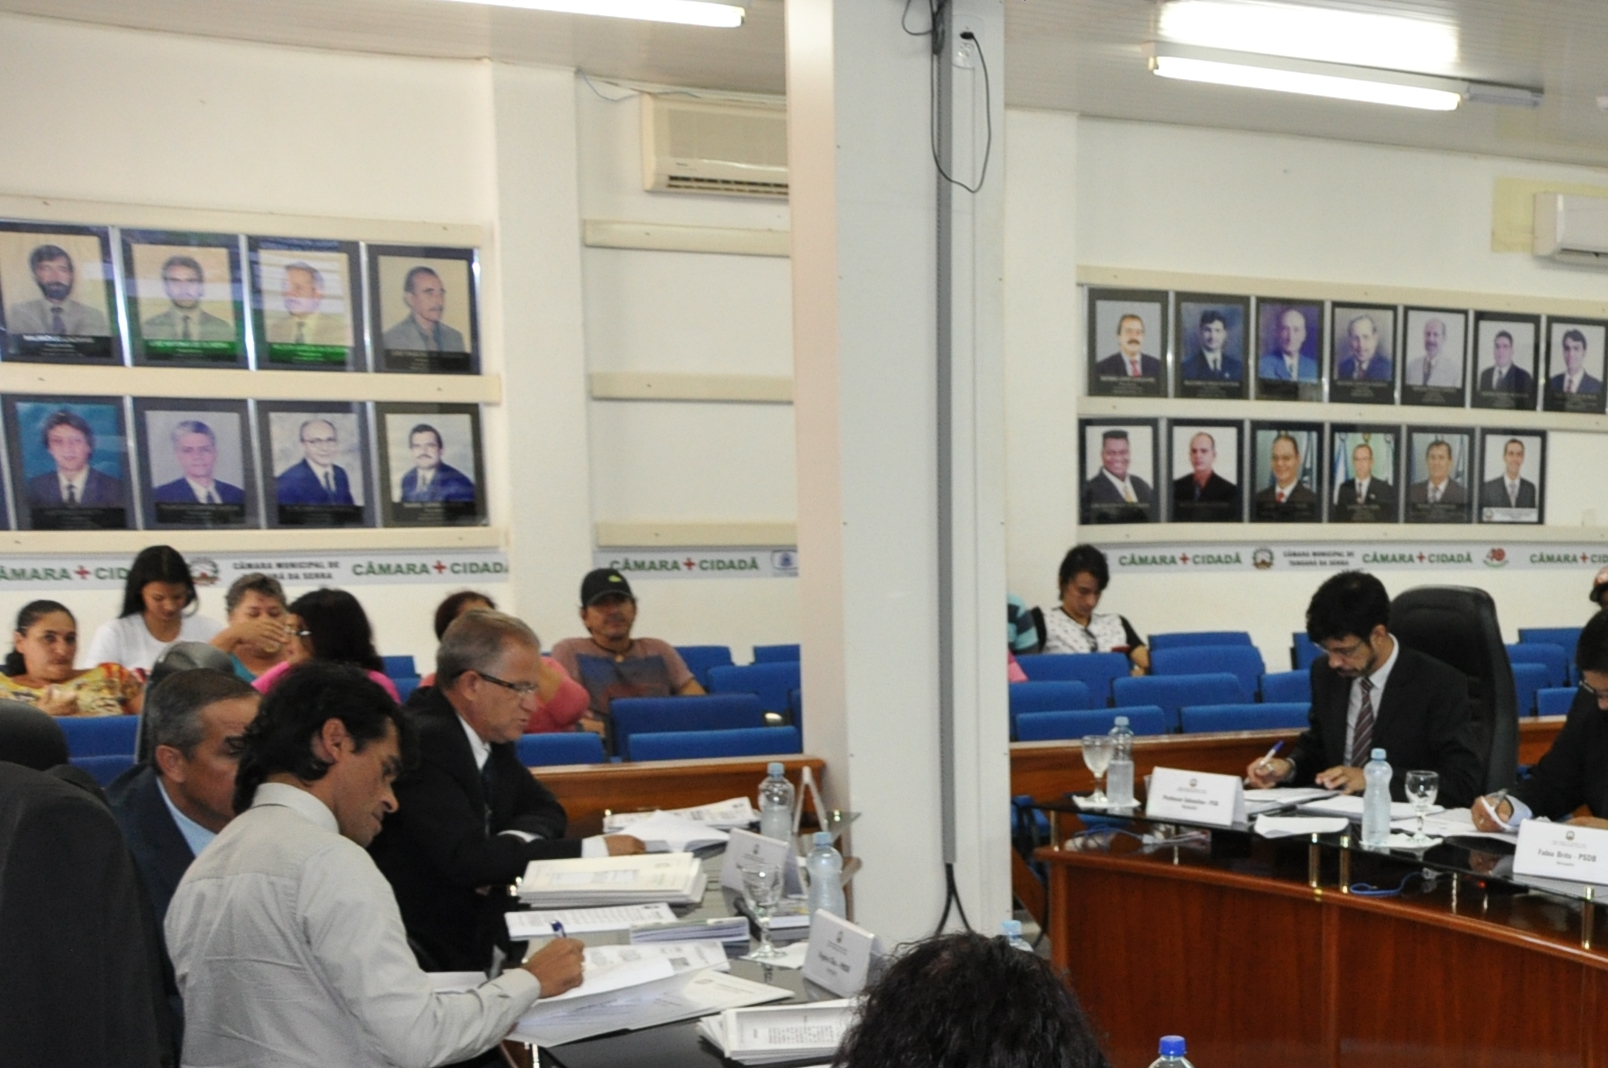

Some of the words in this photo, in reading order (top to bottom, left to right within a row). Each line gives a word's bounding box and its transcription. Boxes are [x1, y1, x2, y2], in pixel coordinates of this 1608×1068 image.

[0, 565, 72, 580] ÂMARA
[352, 561, 430, 575] CÂMARA
[451, 562, 508, 574] CIDAD
